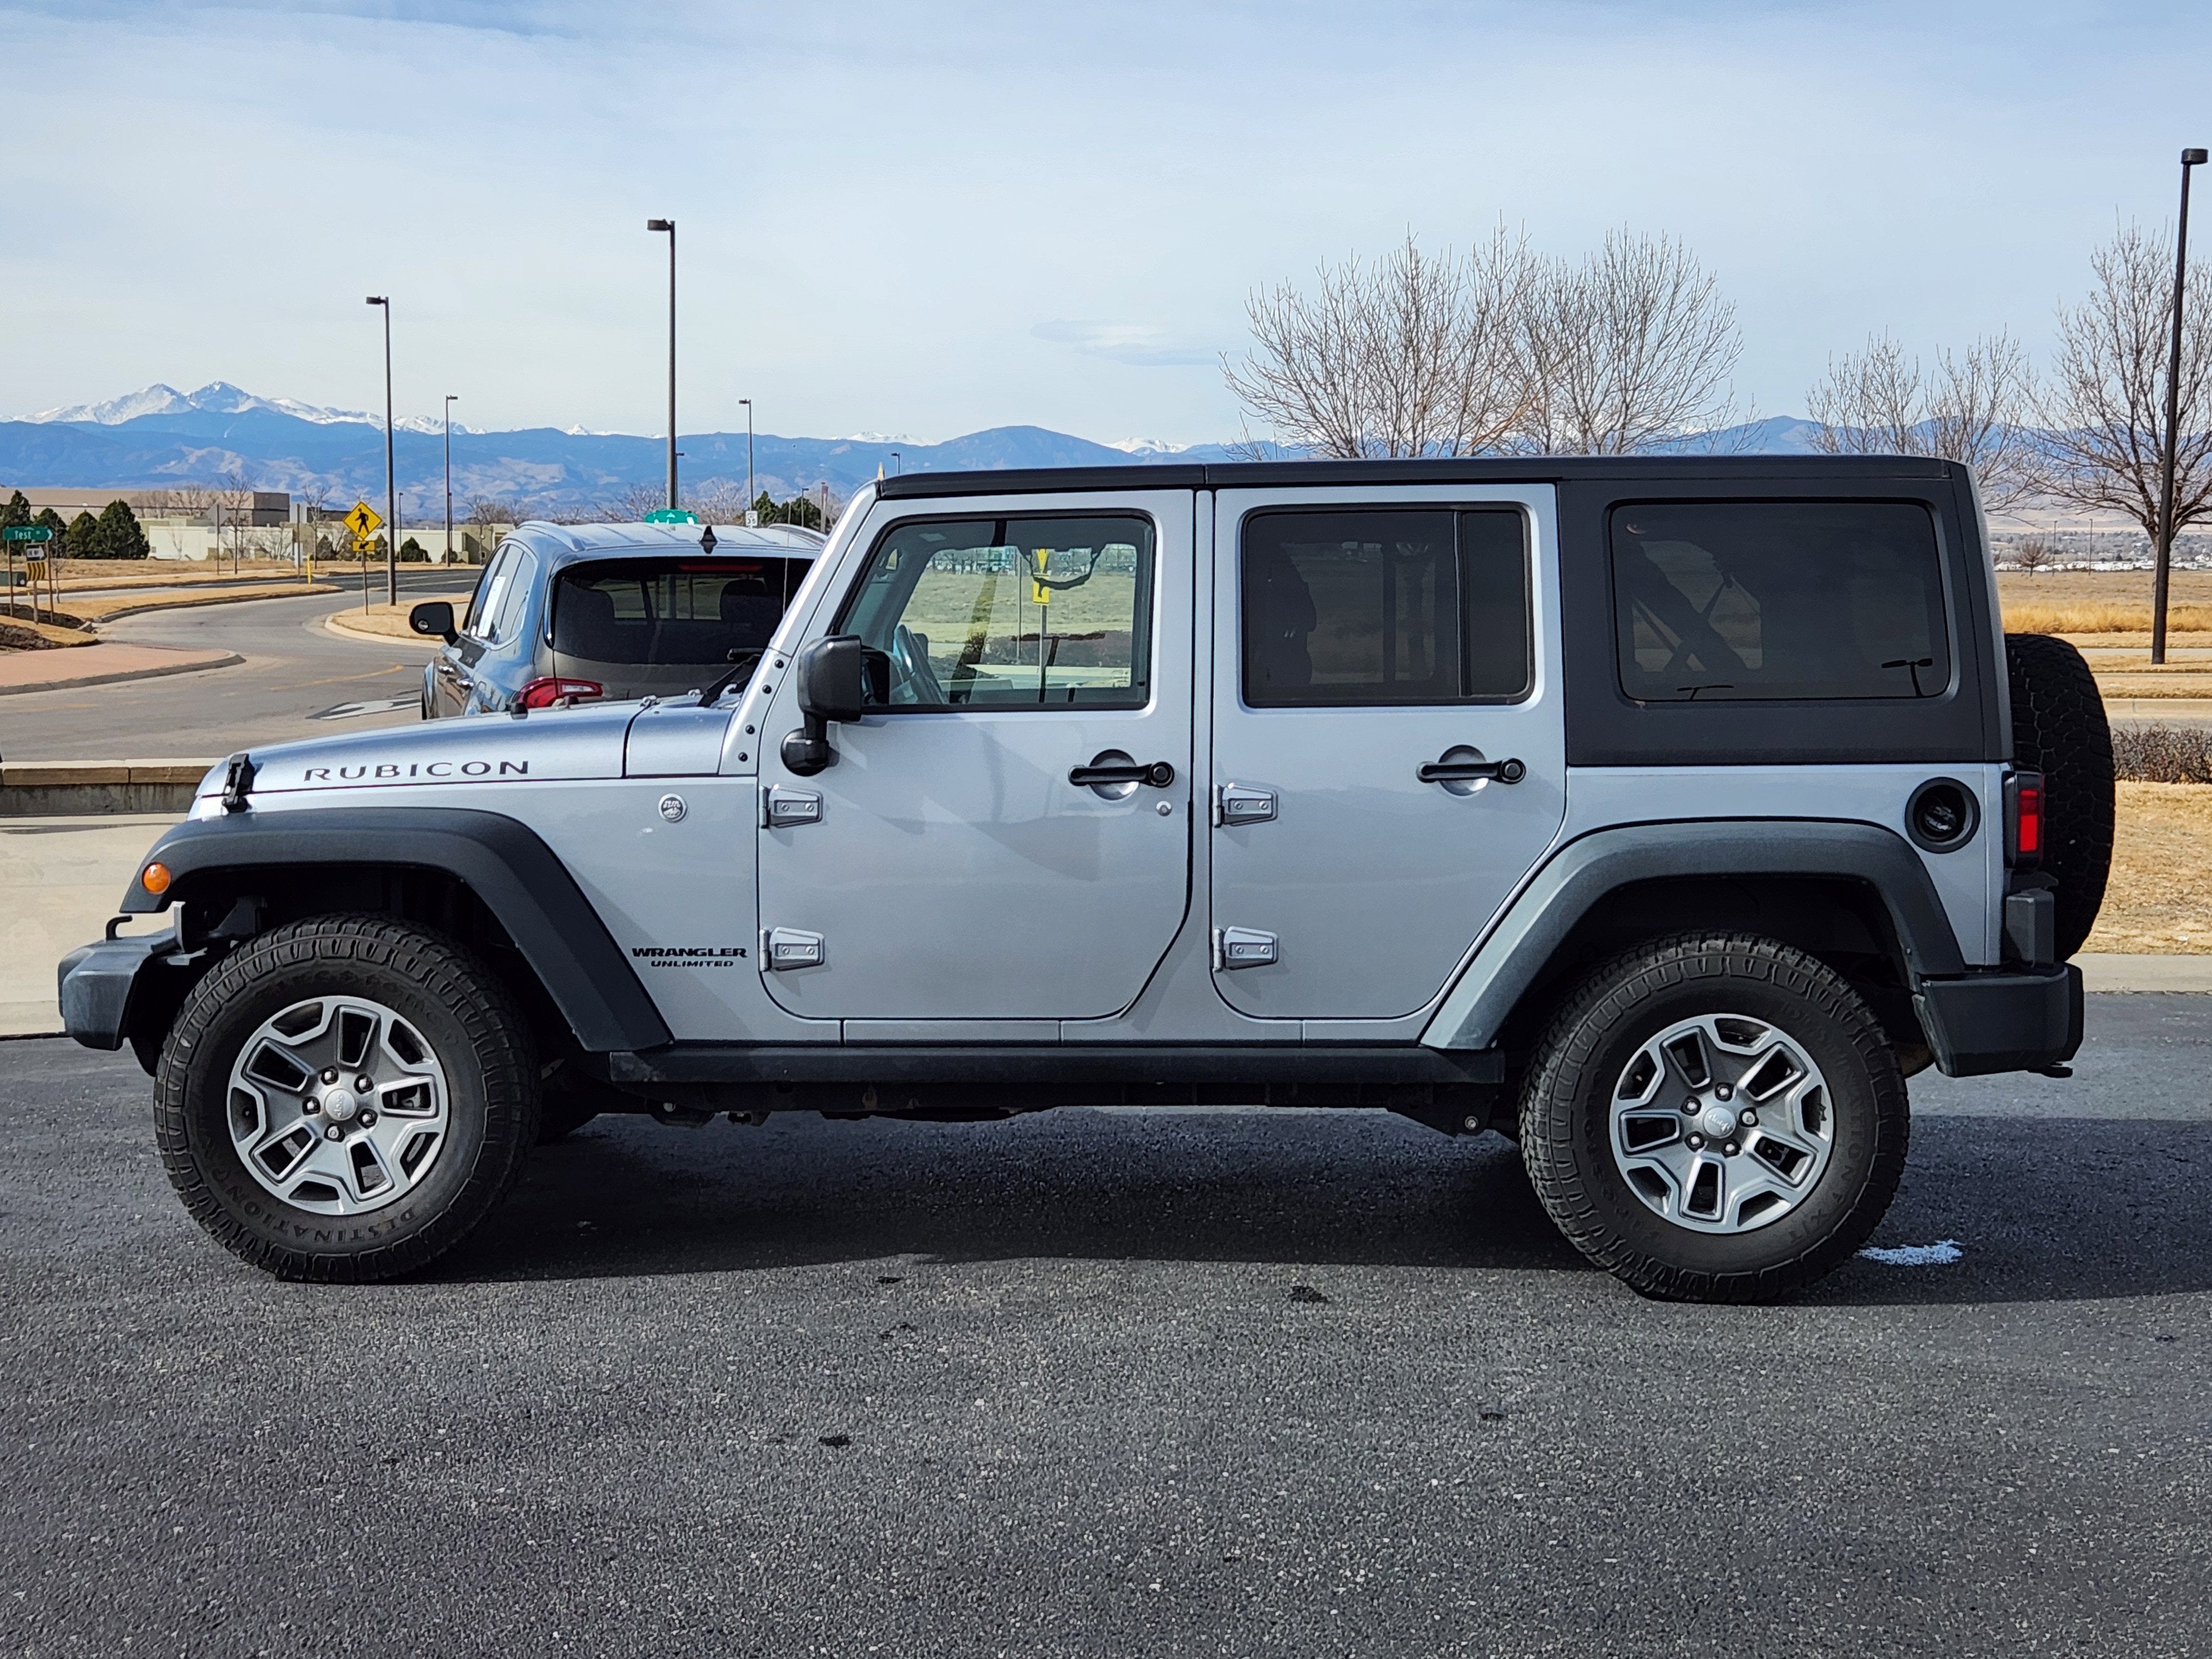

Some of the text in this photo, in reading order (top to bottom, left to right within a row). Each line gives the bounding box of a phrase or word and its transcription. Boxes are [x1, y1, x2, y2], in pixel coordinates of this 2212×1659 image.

[304, 760, 529, 781] RUBICON
[632, 948, 748, 958] WRANGLER
[224, 1185, 414, 1242] DESTINATION
